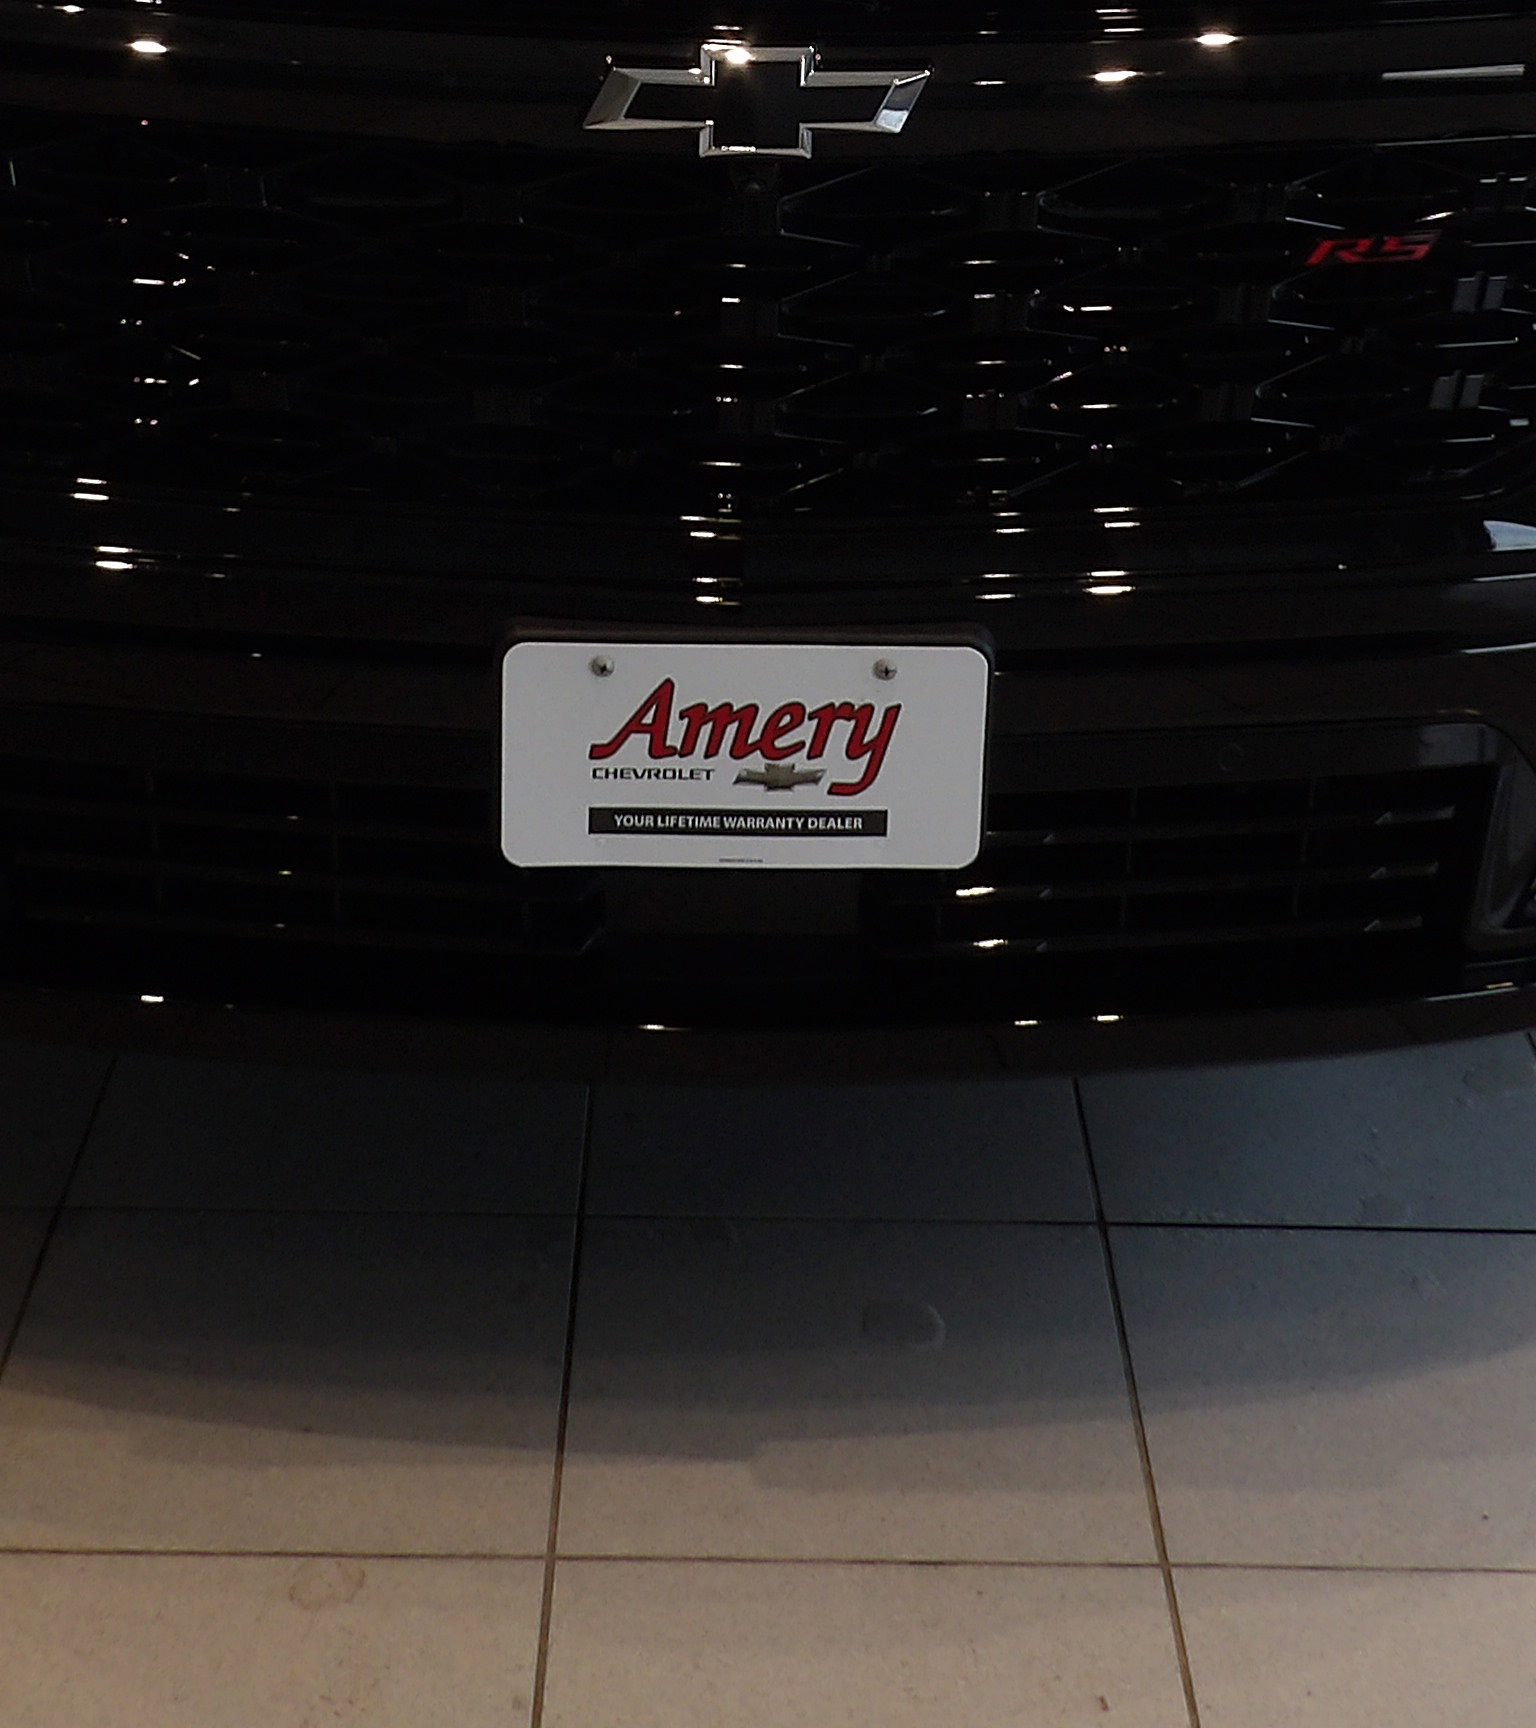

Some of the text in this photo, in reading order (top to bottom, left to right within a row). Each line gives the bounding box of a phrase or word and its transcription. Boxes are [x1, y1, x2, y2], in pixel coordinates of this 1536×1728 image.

[1305, 230, 1441, 267] RS
[588, 677, 902, 796] Amery
[591, 767, 716, 781] CHEVROLET
[613, 814, 863, 830] YOUR LIFETIME WARRANTY DEALER
